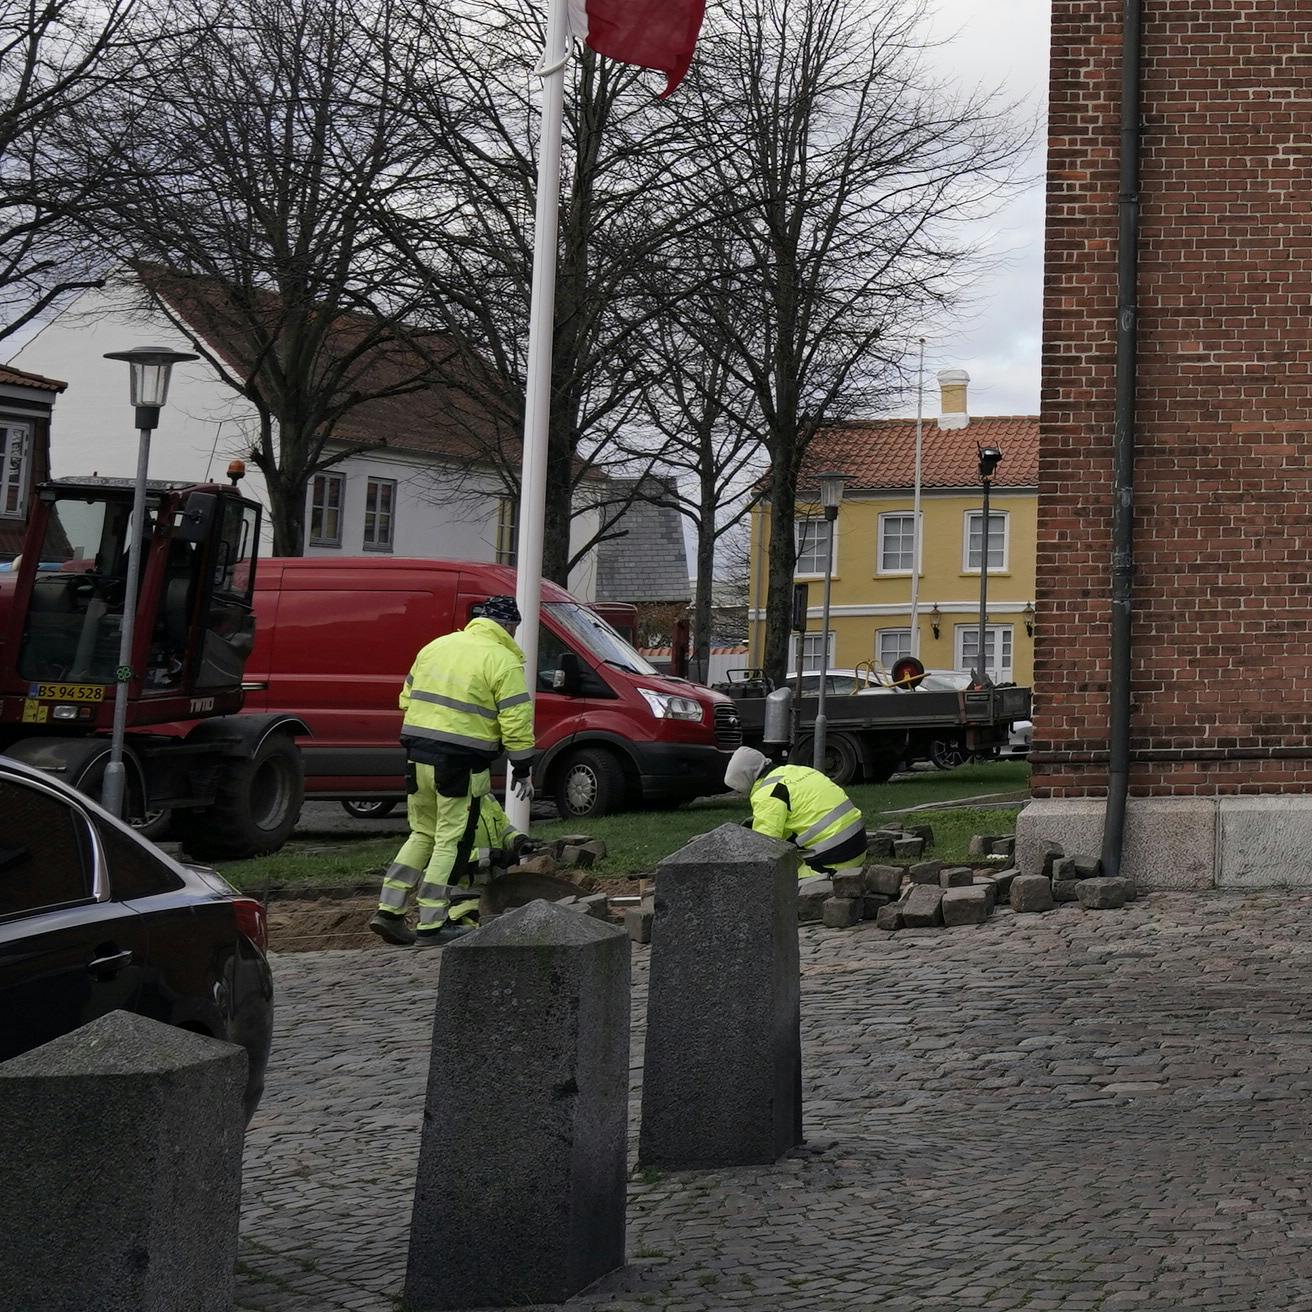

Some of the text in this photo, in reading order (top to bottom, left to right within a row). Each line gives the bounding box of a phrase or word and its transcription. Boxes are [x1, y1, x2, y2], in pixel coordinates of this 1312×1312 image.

[38, 686, 102, 700] BS 94 528
